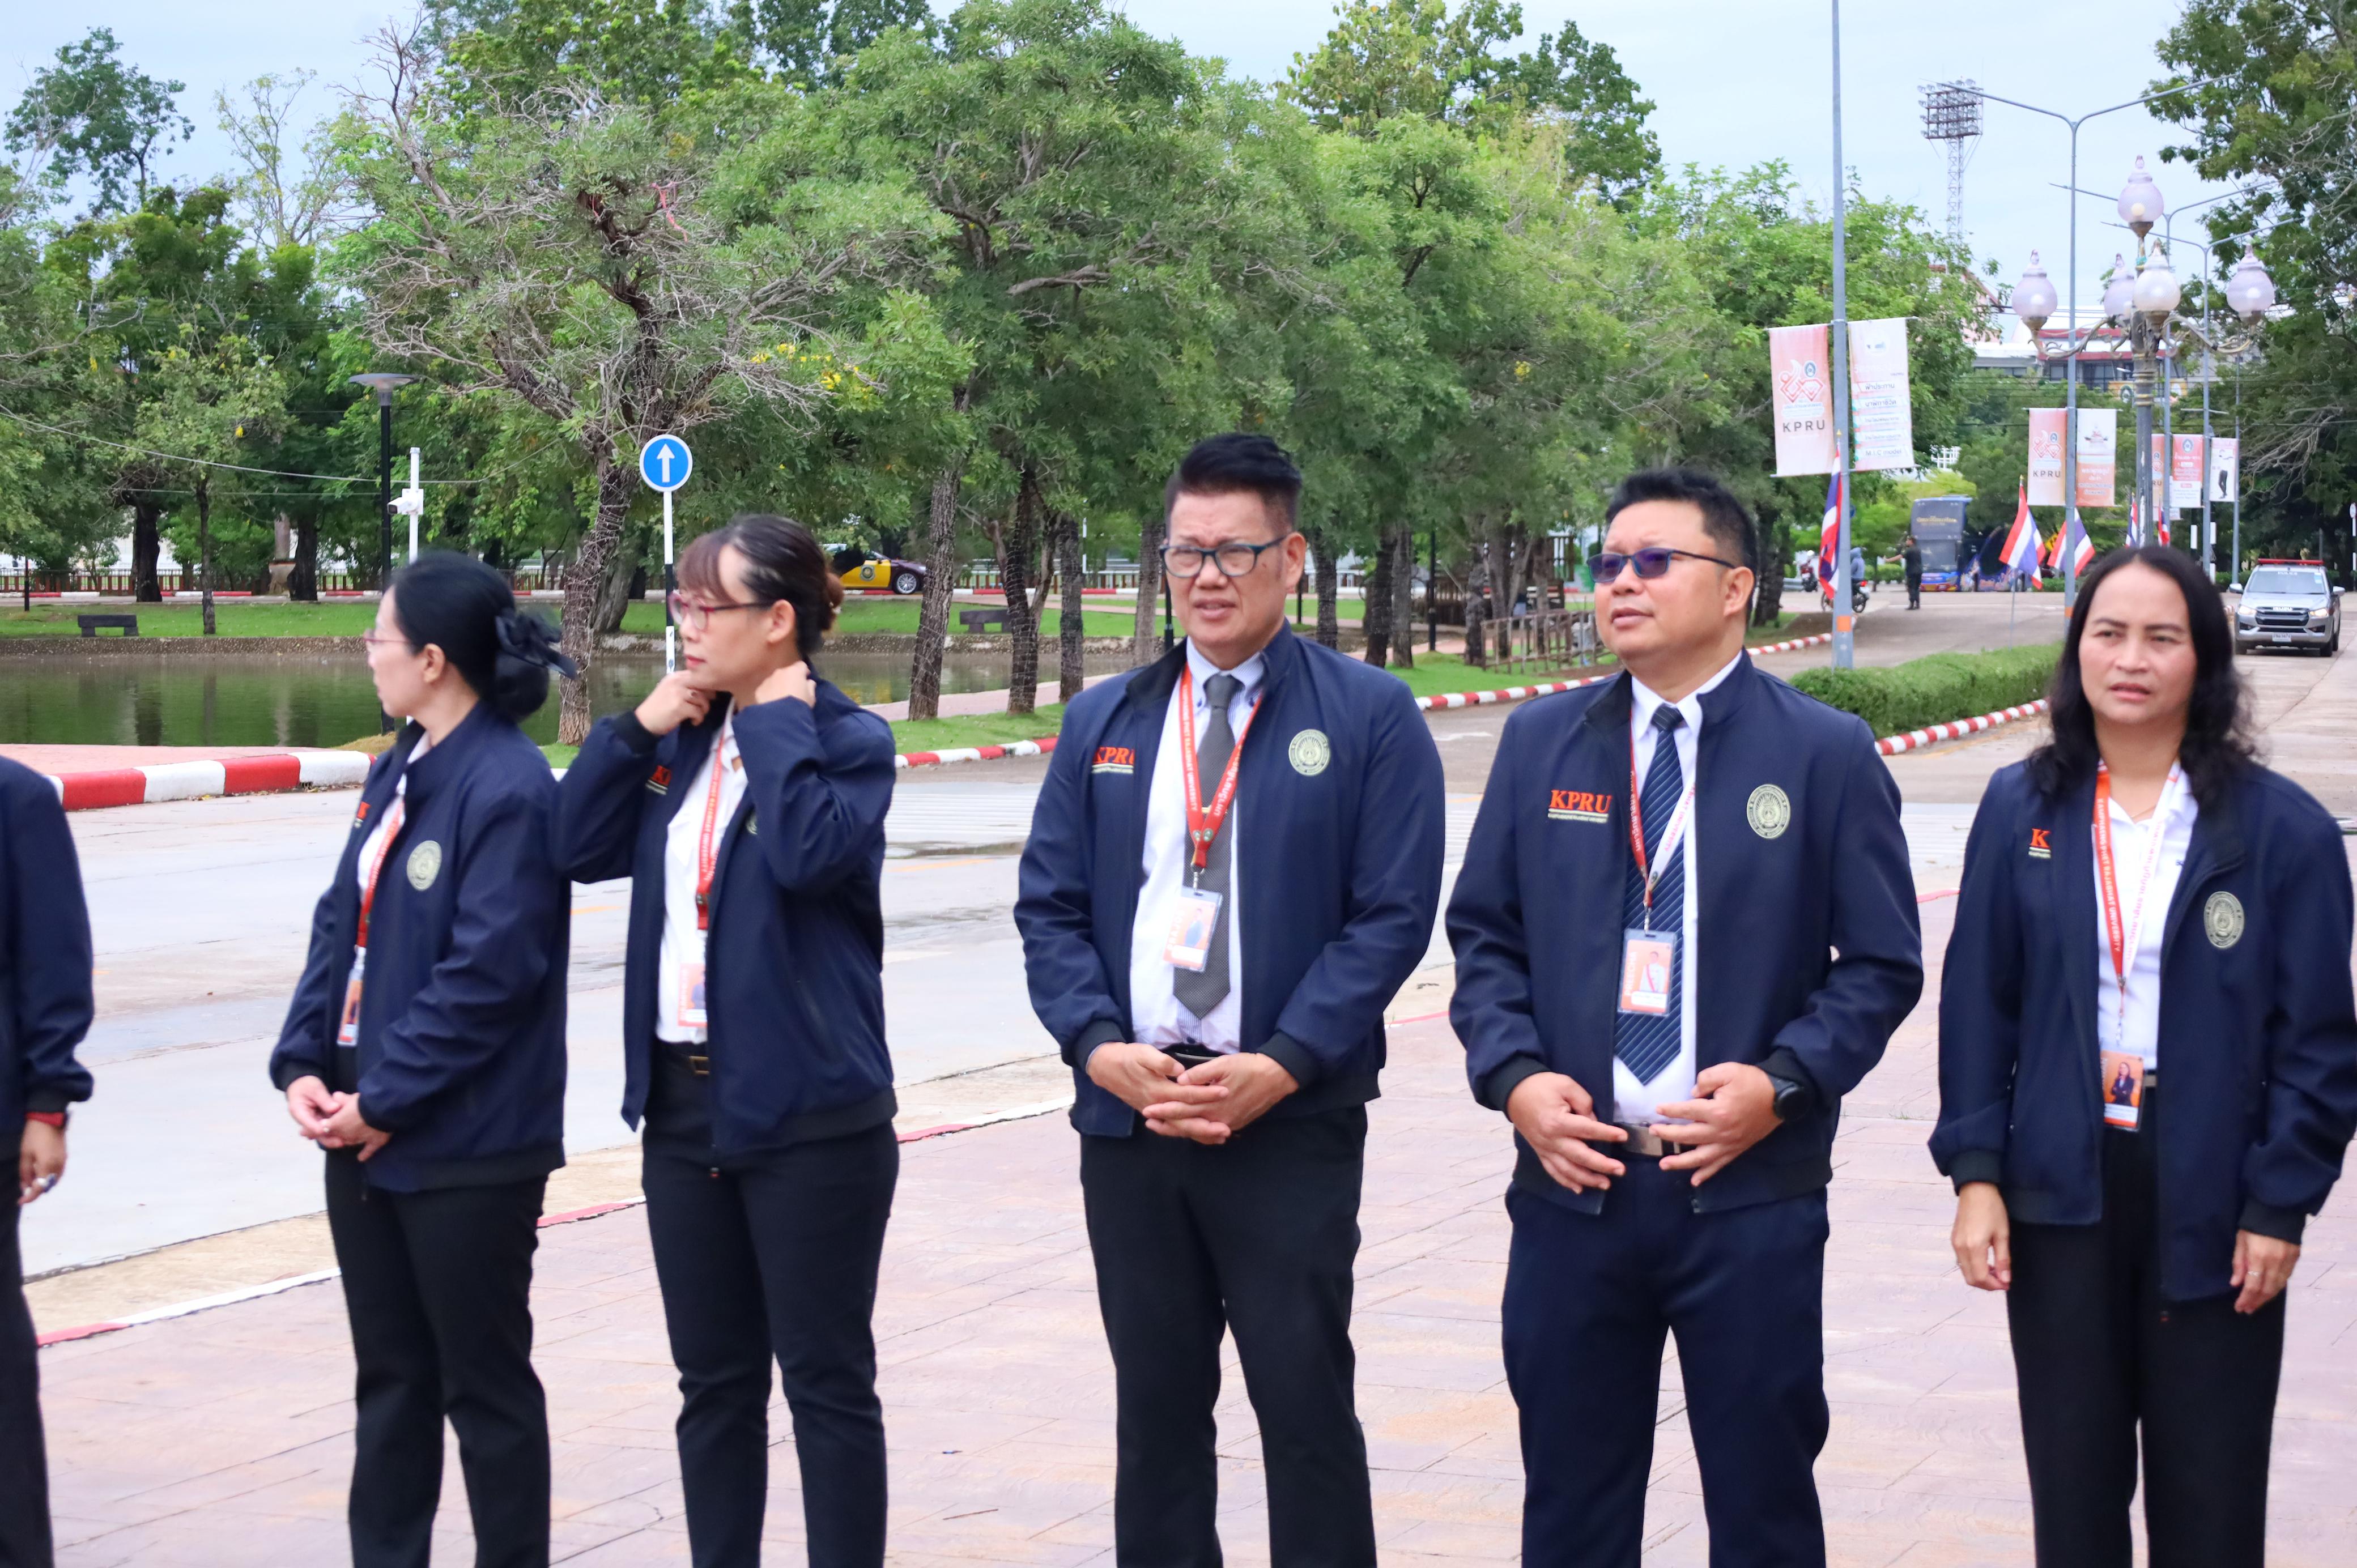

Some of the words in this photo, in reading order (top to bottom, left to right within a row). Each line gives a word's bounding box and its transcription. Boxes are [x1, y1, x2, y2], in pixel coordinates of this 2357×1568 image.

[1782, 420, 1826, 433] KPRU
[1187, 772, 1198, 812] UNIVERSITY
[1549, 790, 1613, 813] KPRU
[2103, 866, 2115, 905] RAJABHAT
[2108, 906, 2121, 952] UNIVERSITY
